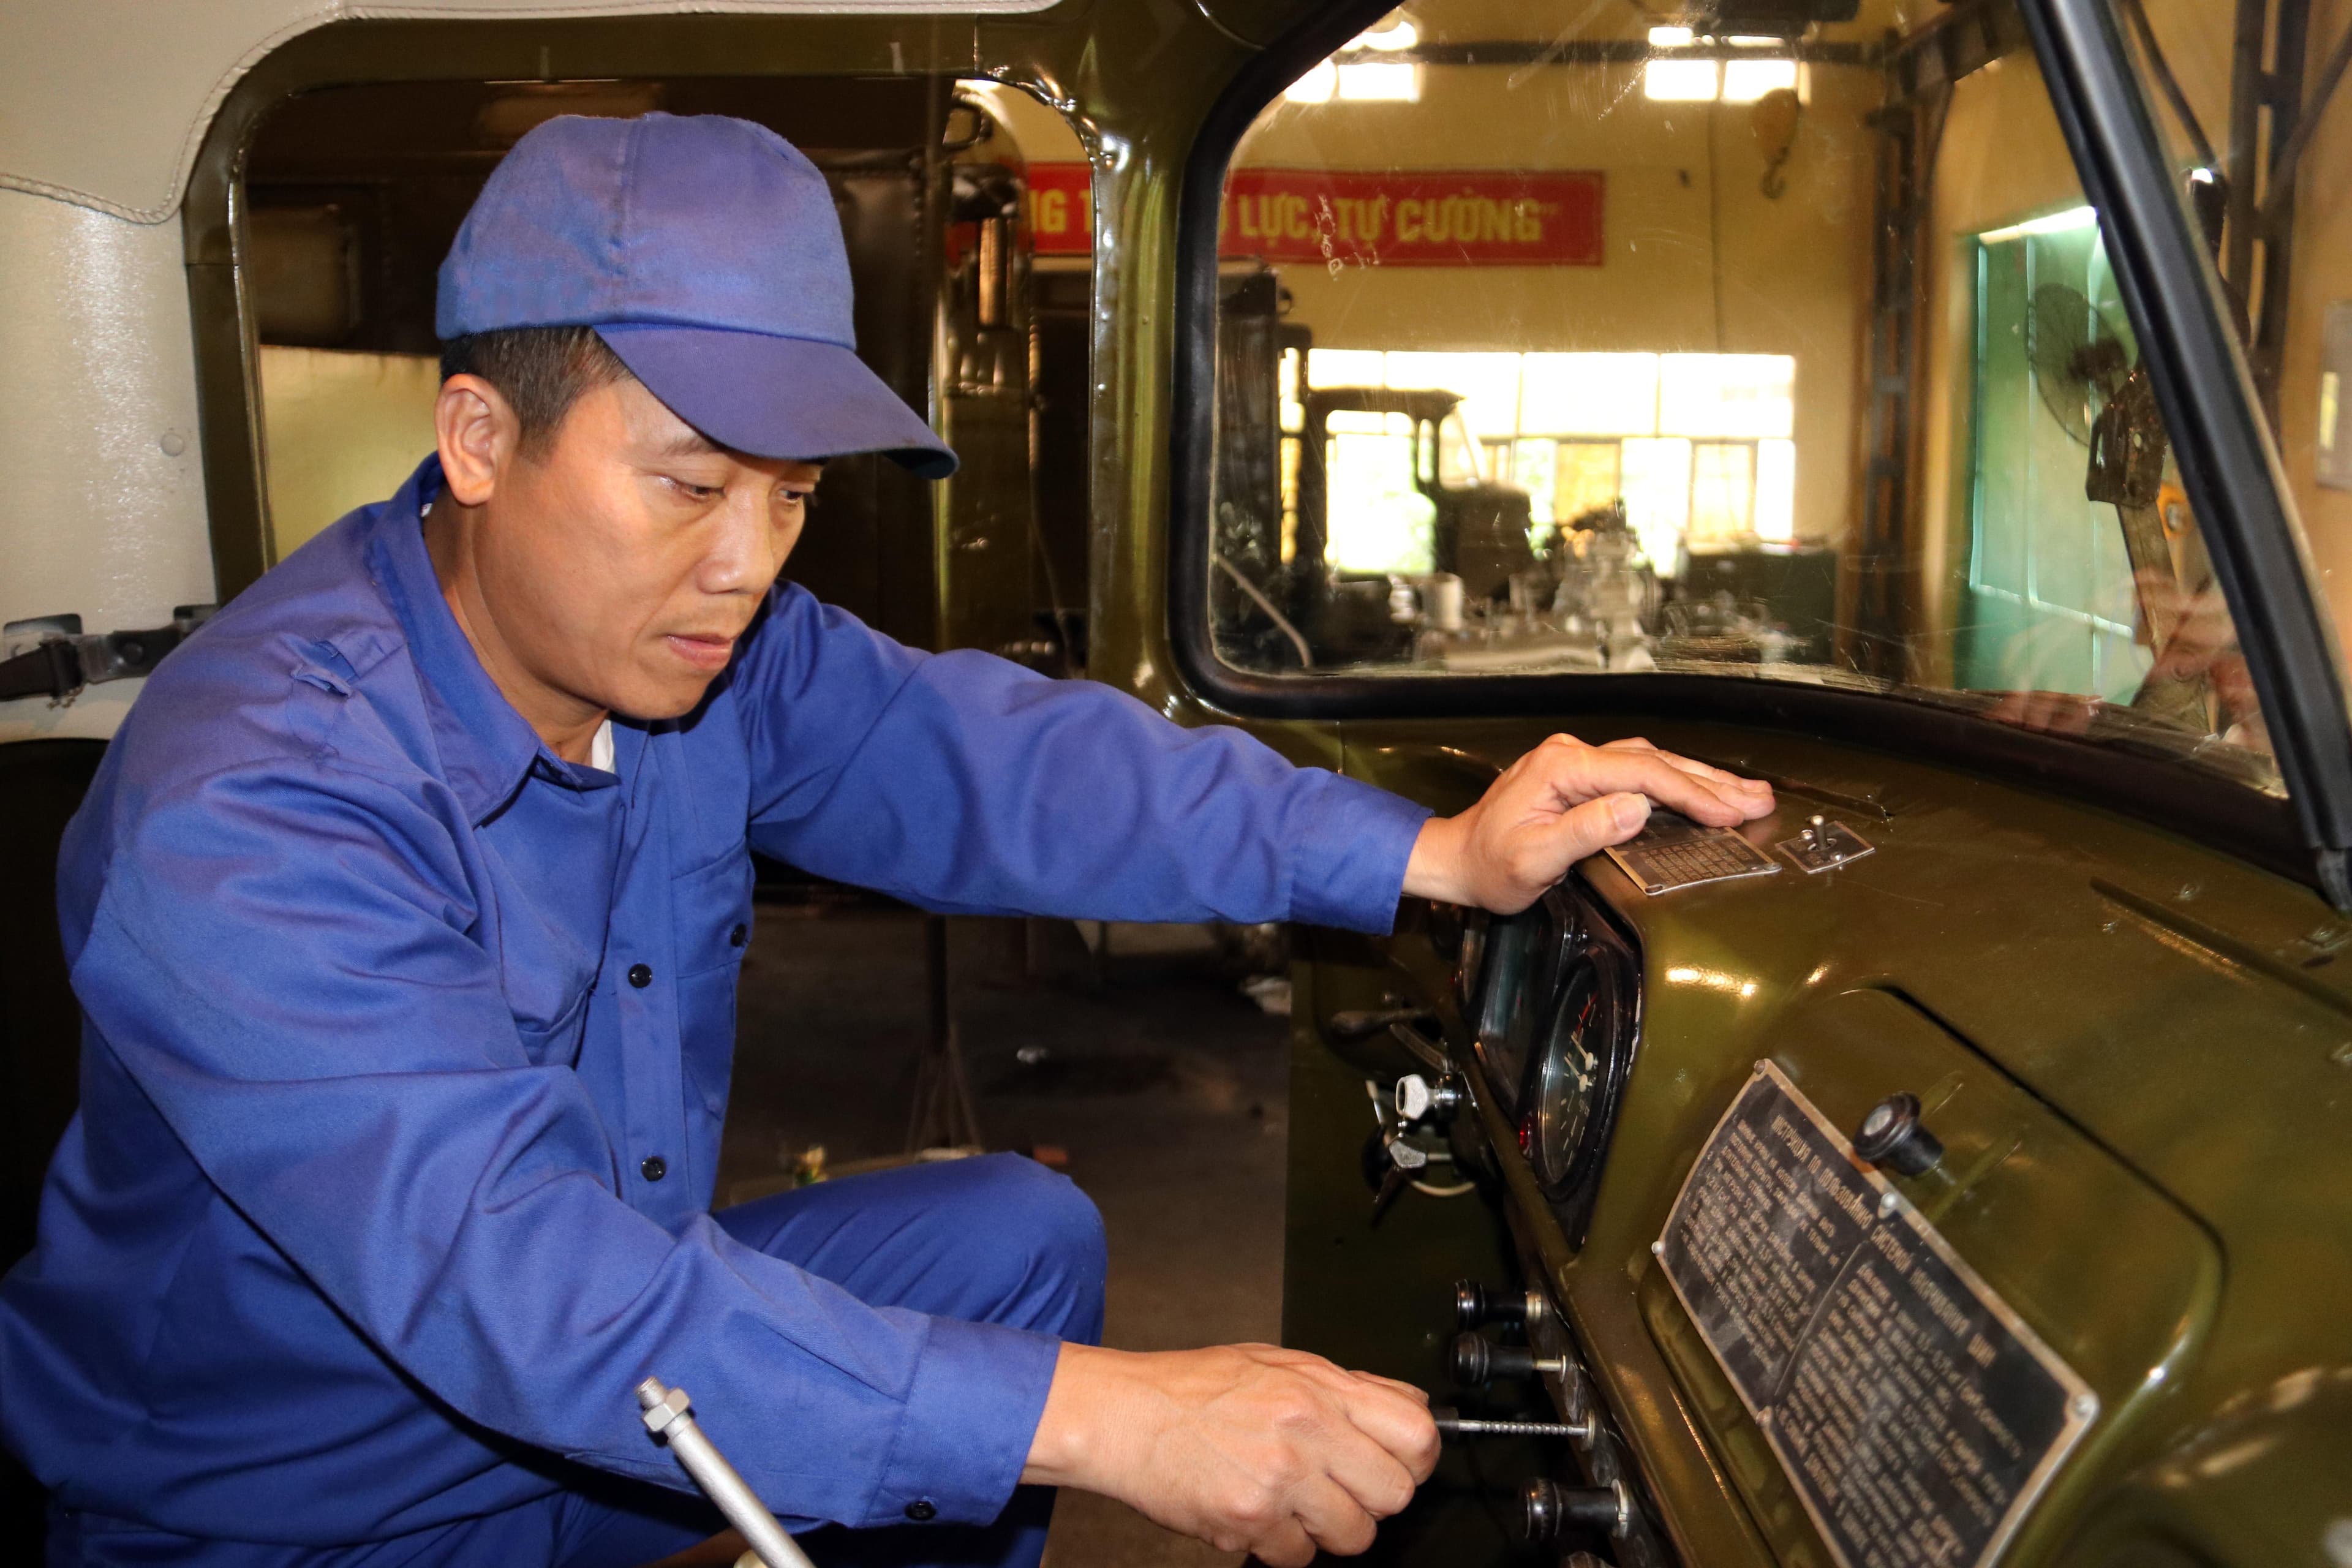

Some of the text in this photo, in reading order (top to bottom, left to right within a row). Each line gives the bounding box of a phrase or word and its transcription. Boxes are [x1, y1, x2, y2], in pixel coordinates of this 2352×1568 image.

[1332, 192, 1385, 248] TỰ
[1770, 1112, 1812, 1165] ИНСТРУКЦИЯ
[1807, 1153, 1822, 1175] ПО
[1817, 1164, 1873, 1233] ПОЛЬЗОВАНИЮ
